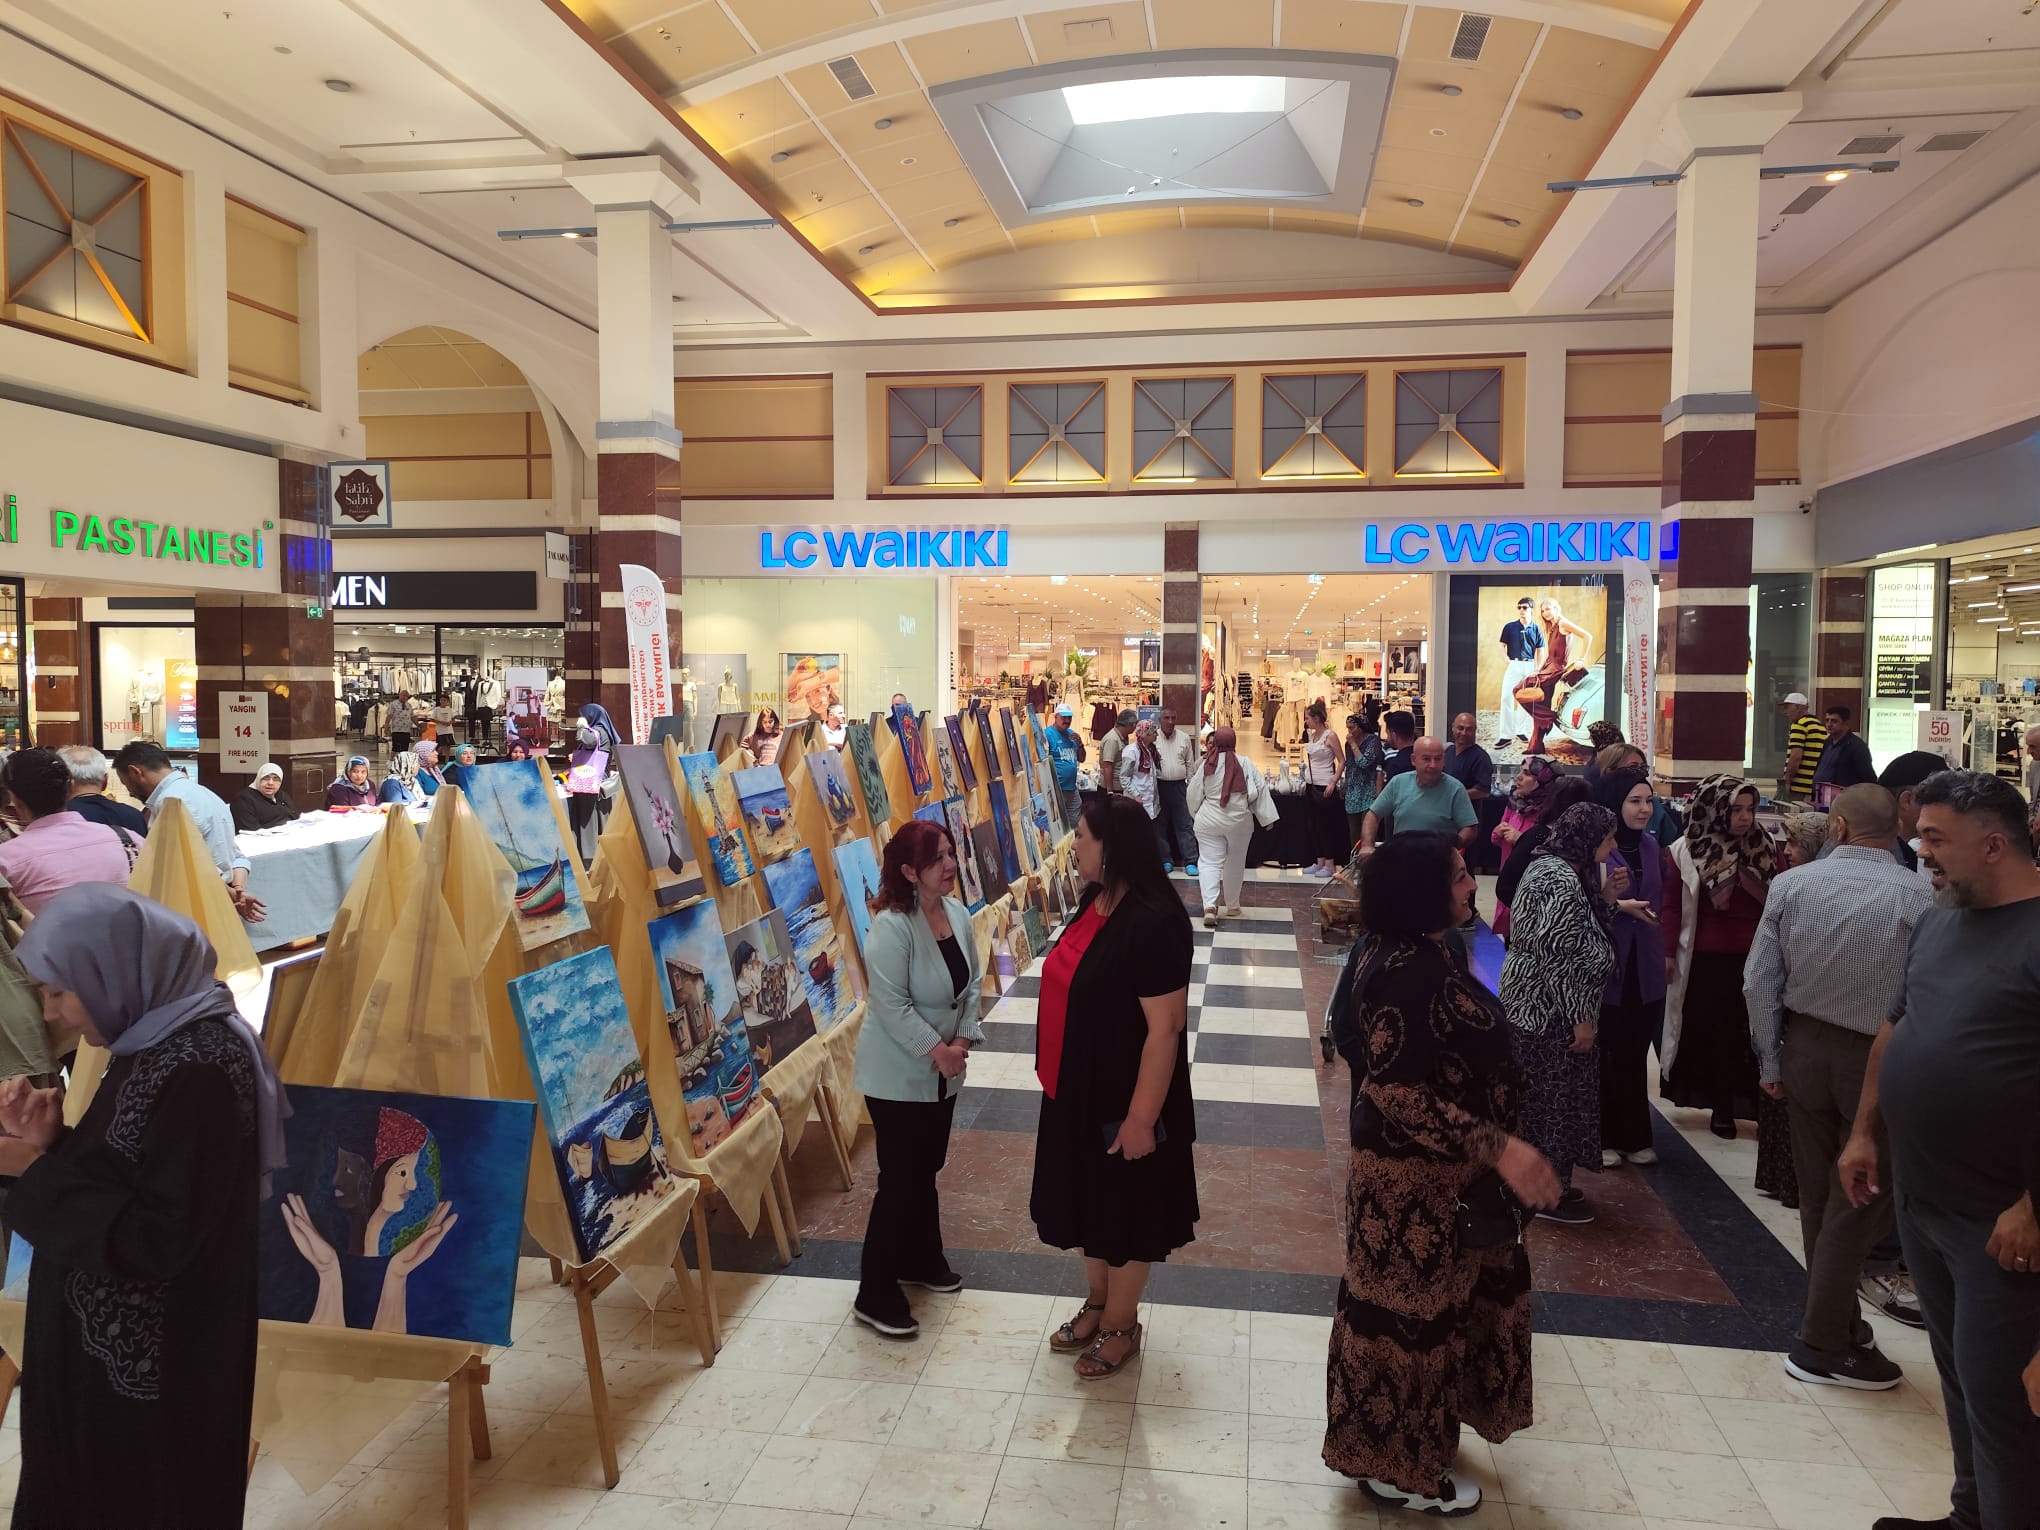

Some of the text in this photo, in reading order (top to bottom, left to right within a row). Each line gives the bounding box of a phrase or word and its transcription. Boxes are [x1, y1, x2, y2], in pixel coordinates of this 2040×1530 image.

[52, 510, 264, 569] PASTANESİ
[1365, 523, 1430, 564] LC
[761, 531, 818, 569] LC
[1878, 583, 1933, 591] SHOP ONLIN
[229, 705, 256, 713] YANGIN
[234, 725, 252, 738] 14
[1931, 721, 1949, 736] 50
[242, 750, 259, 758] HOSE
